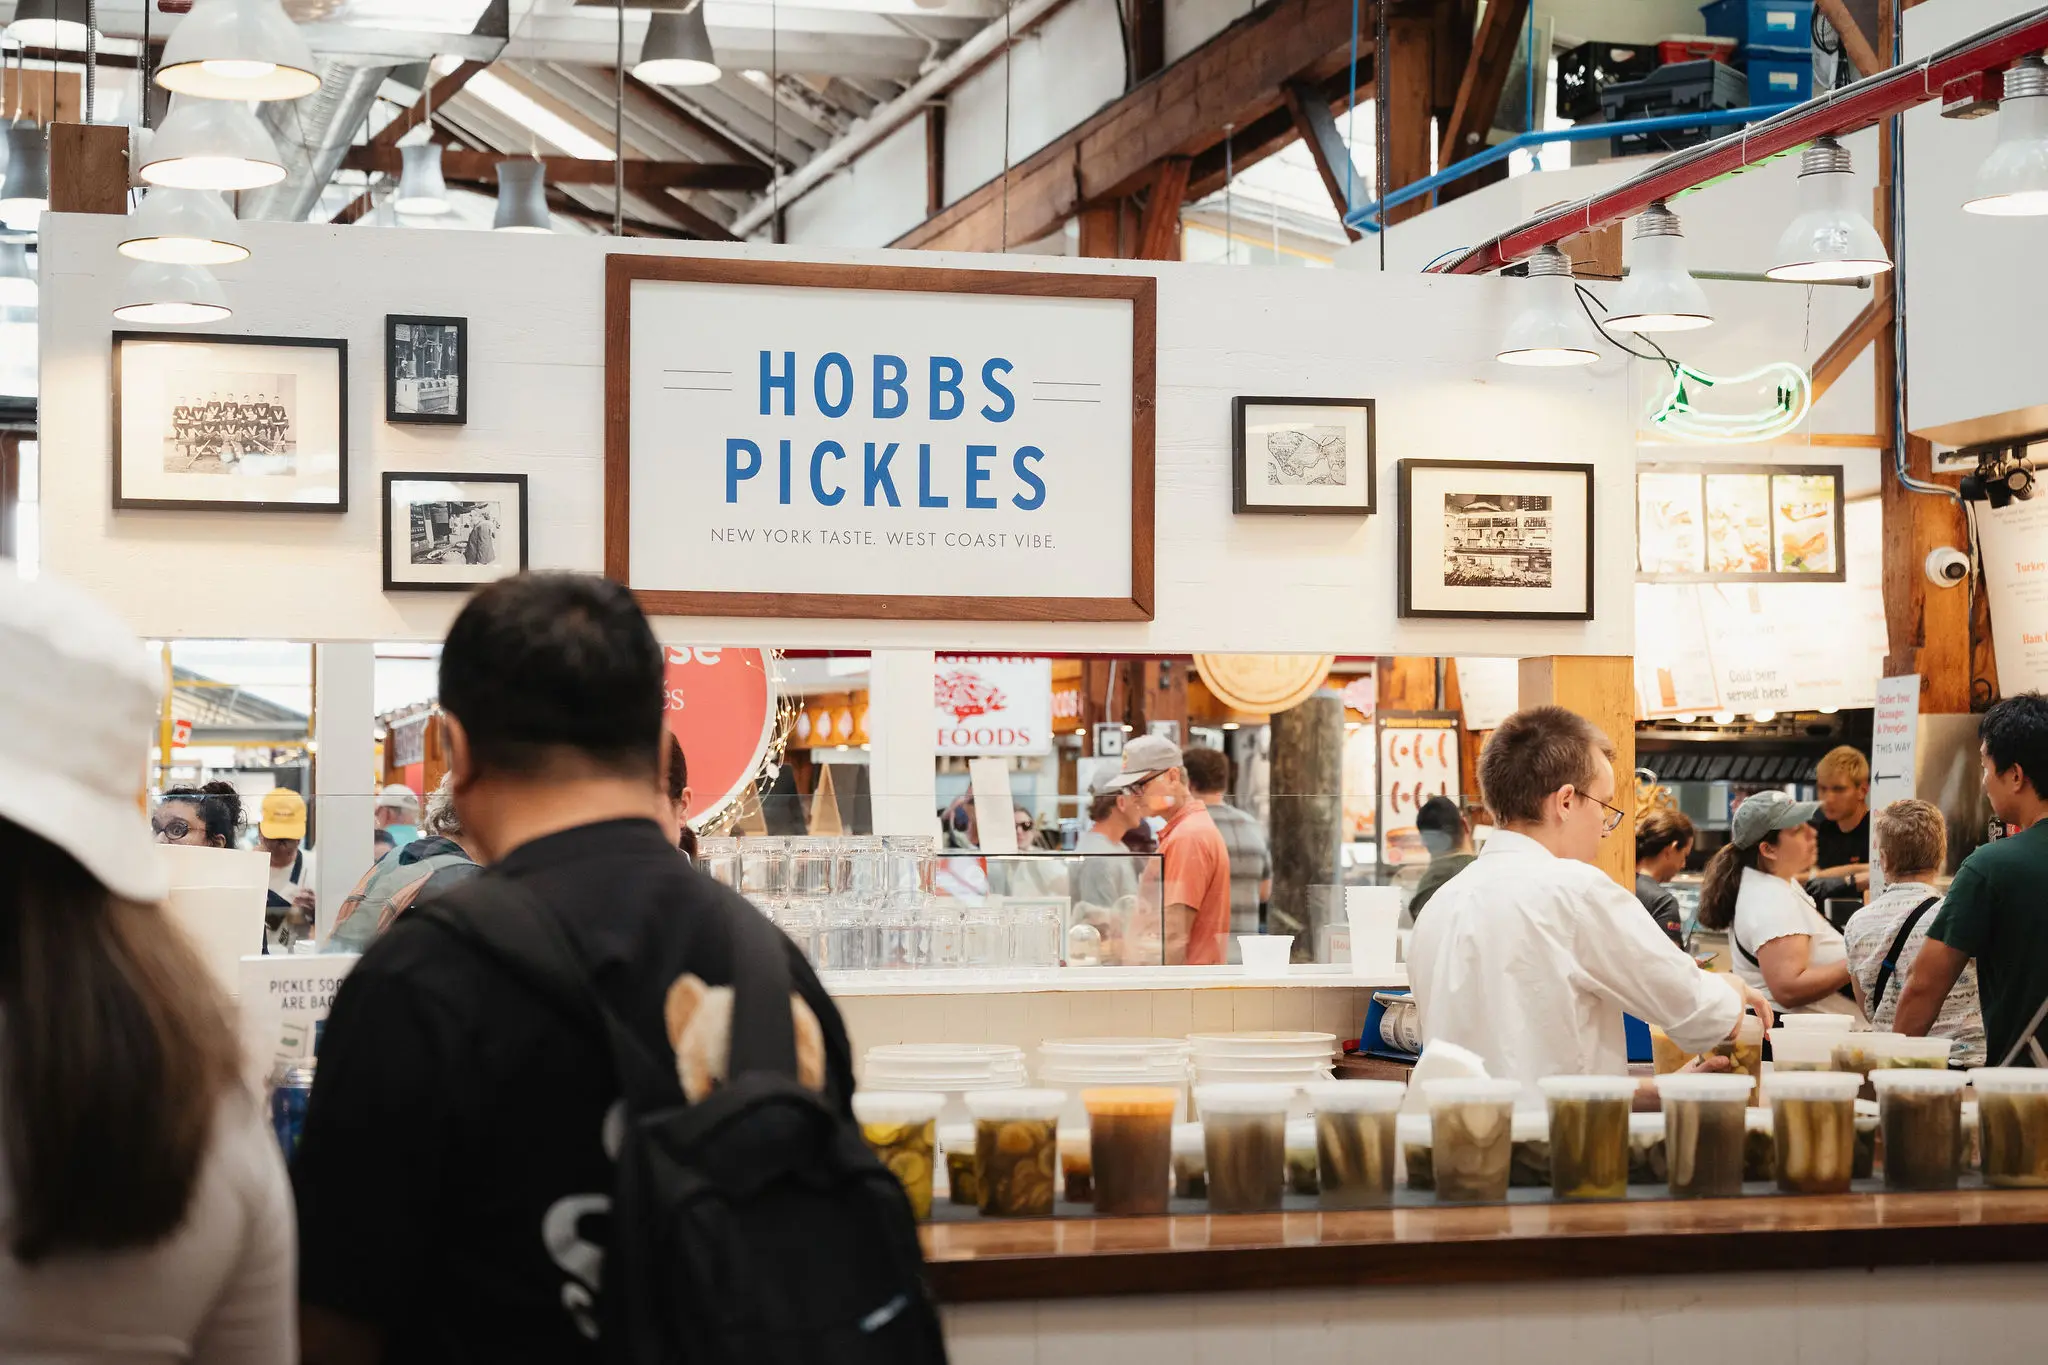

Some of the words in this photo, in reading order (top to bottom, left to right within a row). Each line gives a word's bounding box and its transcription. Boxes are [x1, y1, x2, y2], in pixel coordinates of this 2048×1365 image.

[760, 350, 1015, 423] HOBBS
[725, 438, 1046, 511] PICKLES
[711, 528, 756, 543] NEW
[762, 529, 812, 544] YORK
[820, 530, 876, 545] TASTE.
[886, 532, 937, 547] WEST
[944, 532, 1007, 548] COAST
[1014, 534, 1056, 549] VIBE.
[1876, 743, 1893, 755] THIS
[1894, 742, 1912, 753] WAY
[270, 979, 314, 993] PICKLE
[281, 996, 306, 1010] ARE
